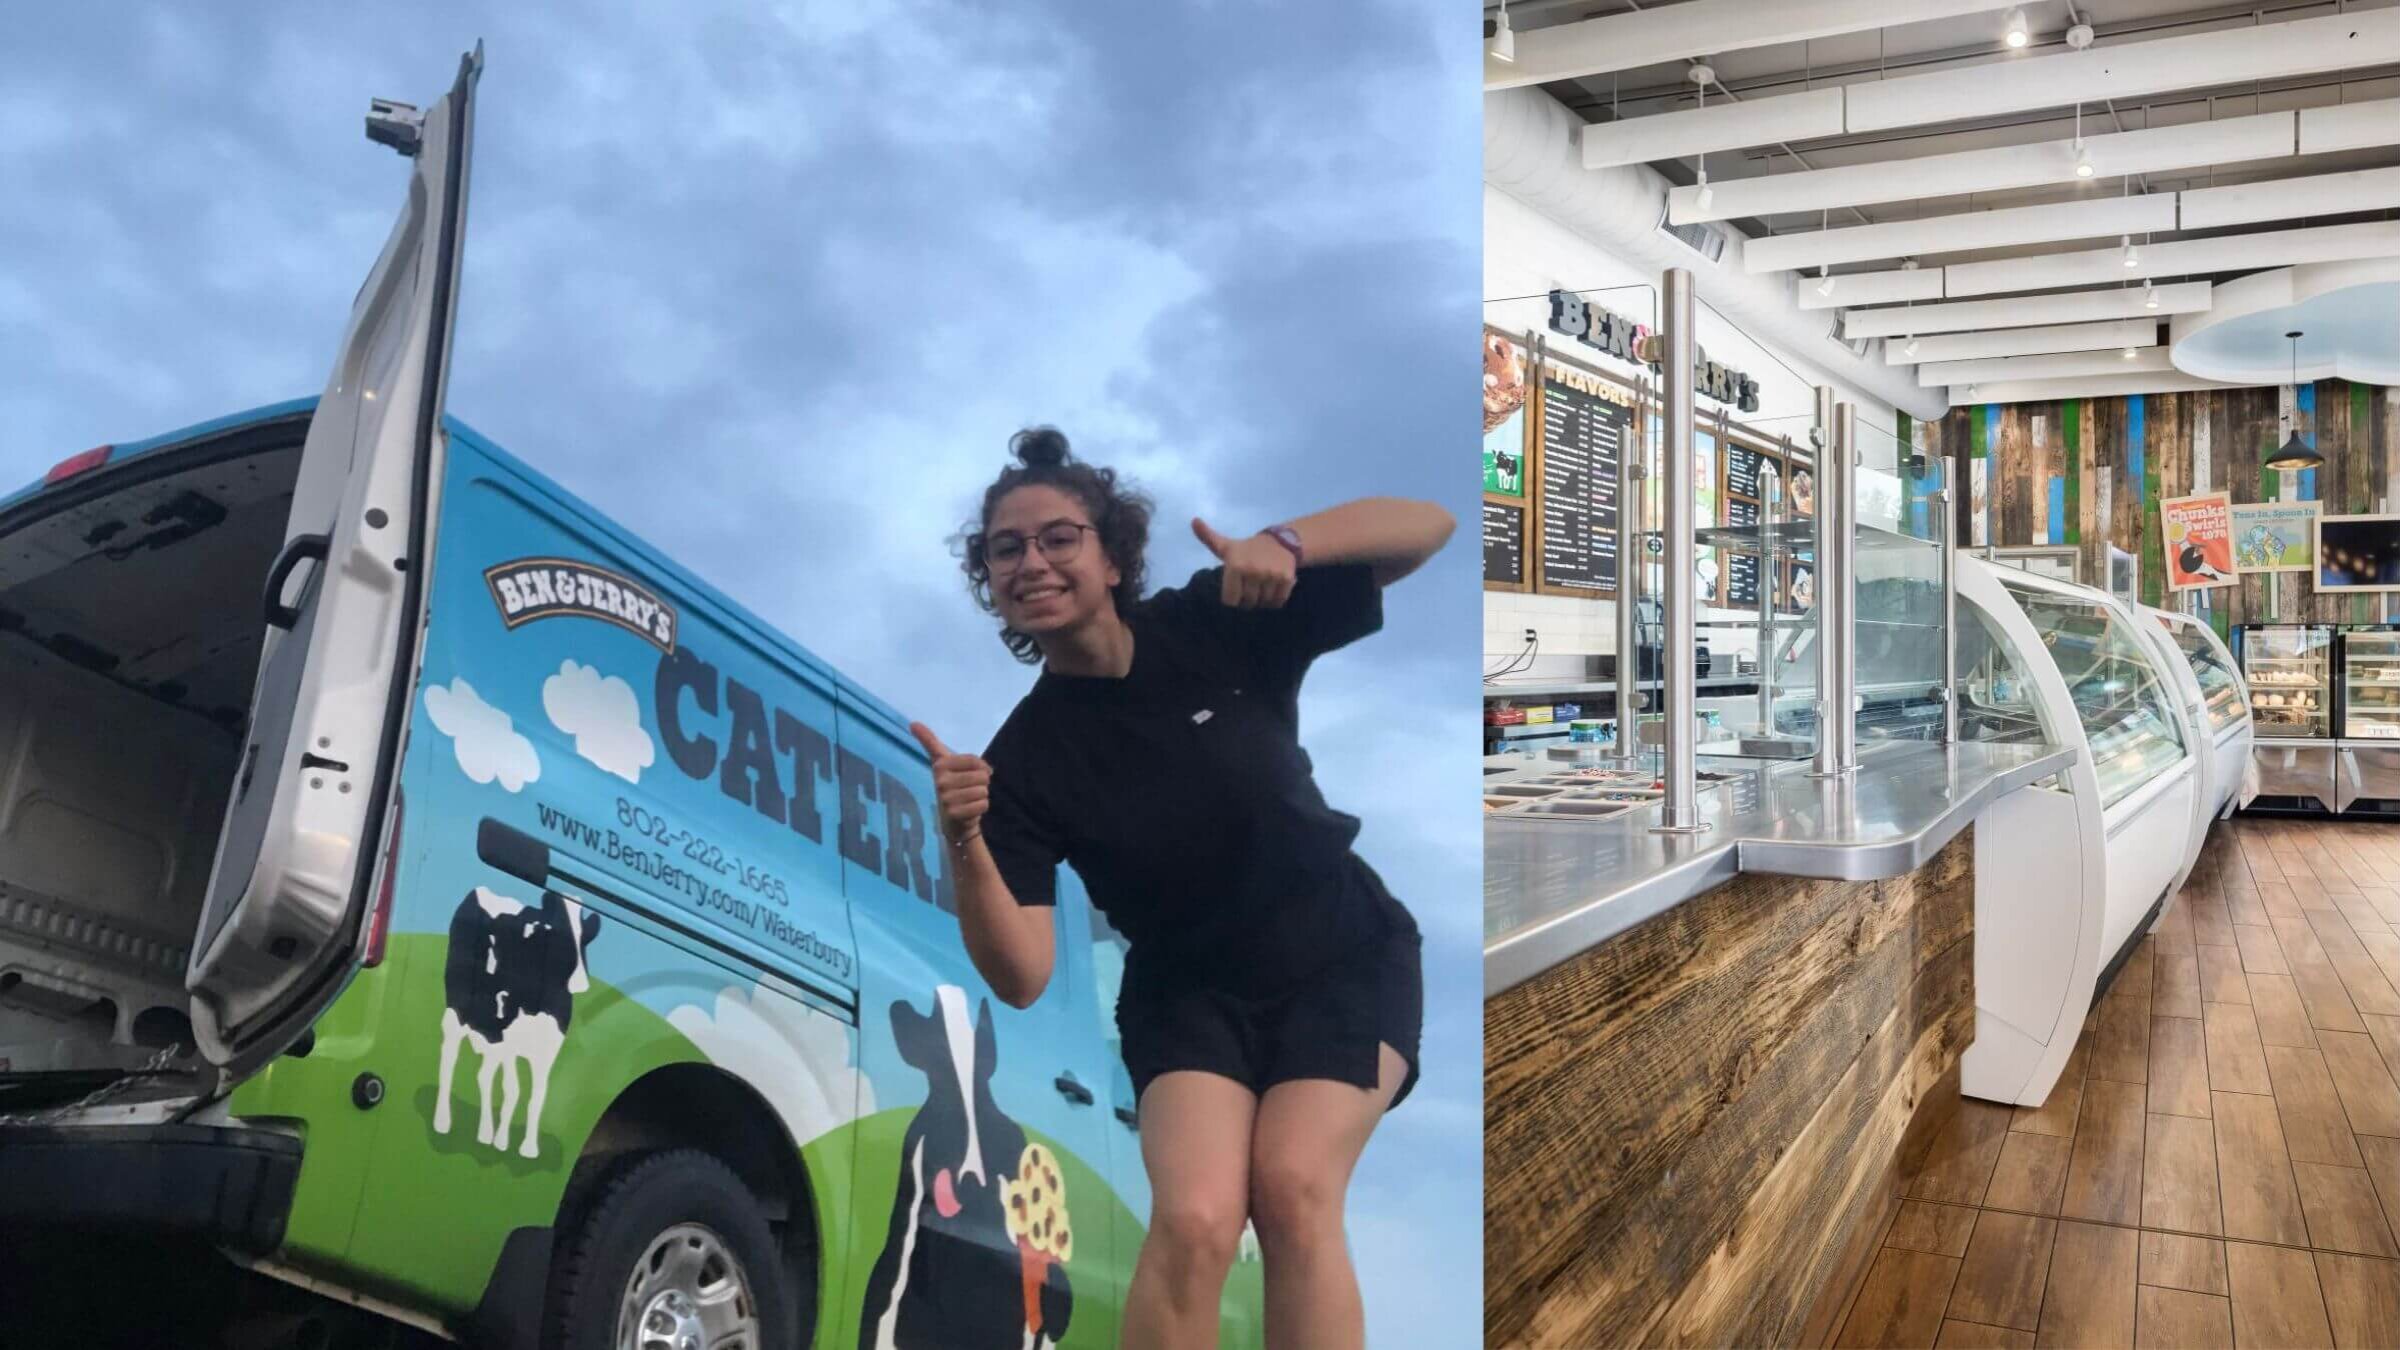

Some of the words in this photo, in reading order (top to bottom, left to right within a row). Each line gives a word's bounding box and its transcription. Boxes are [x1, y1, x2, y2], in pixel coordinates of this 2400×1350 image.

[1556, 367, 1630, 407] FLAVORS
[2167, 504, 2226, 523] Chunks
[2185, 518, 2226, 532] Swirls
[616, 797, 790, 908] 802-222-1665
[536, 802, 852, 978] www.BenJerry.com/Waterbury
